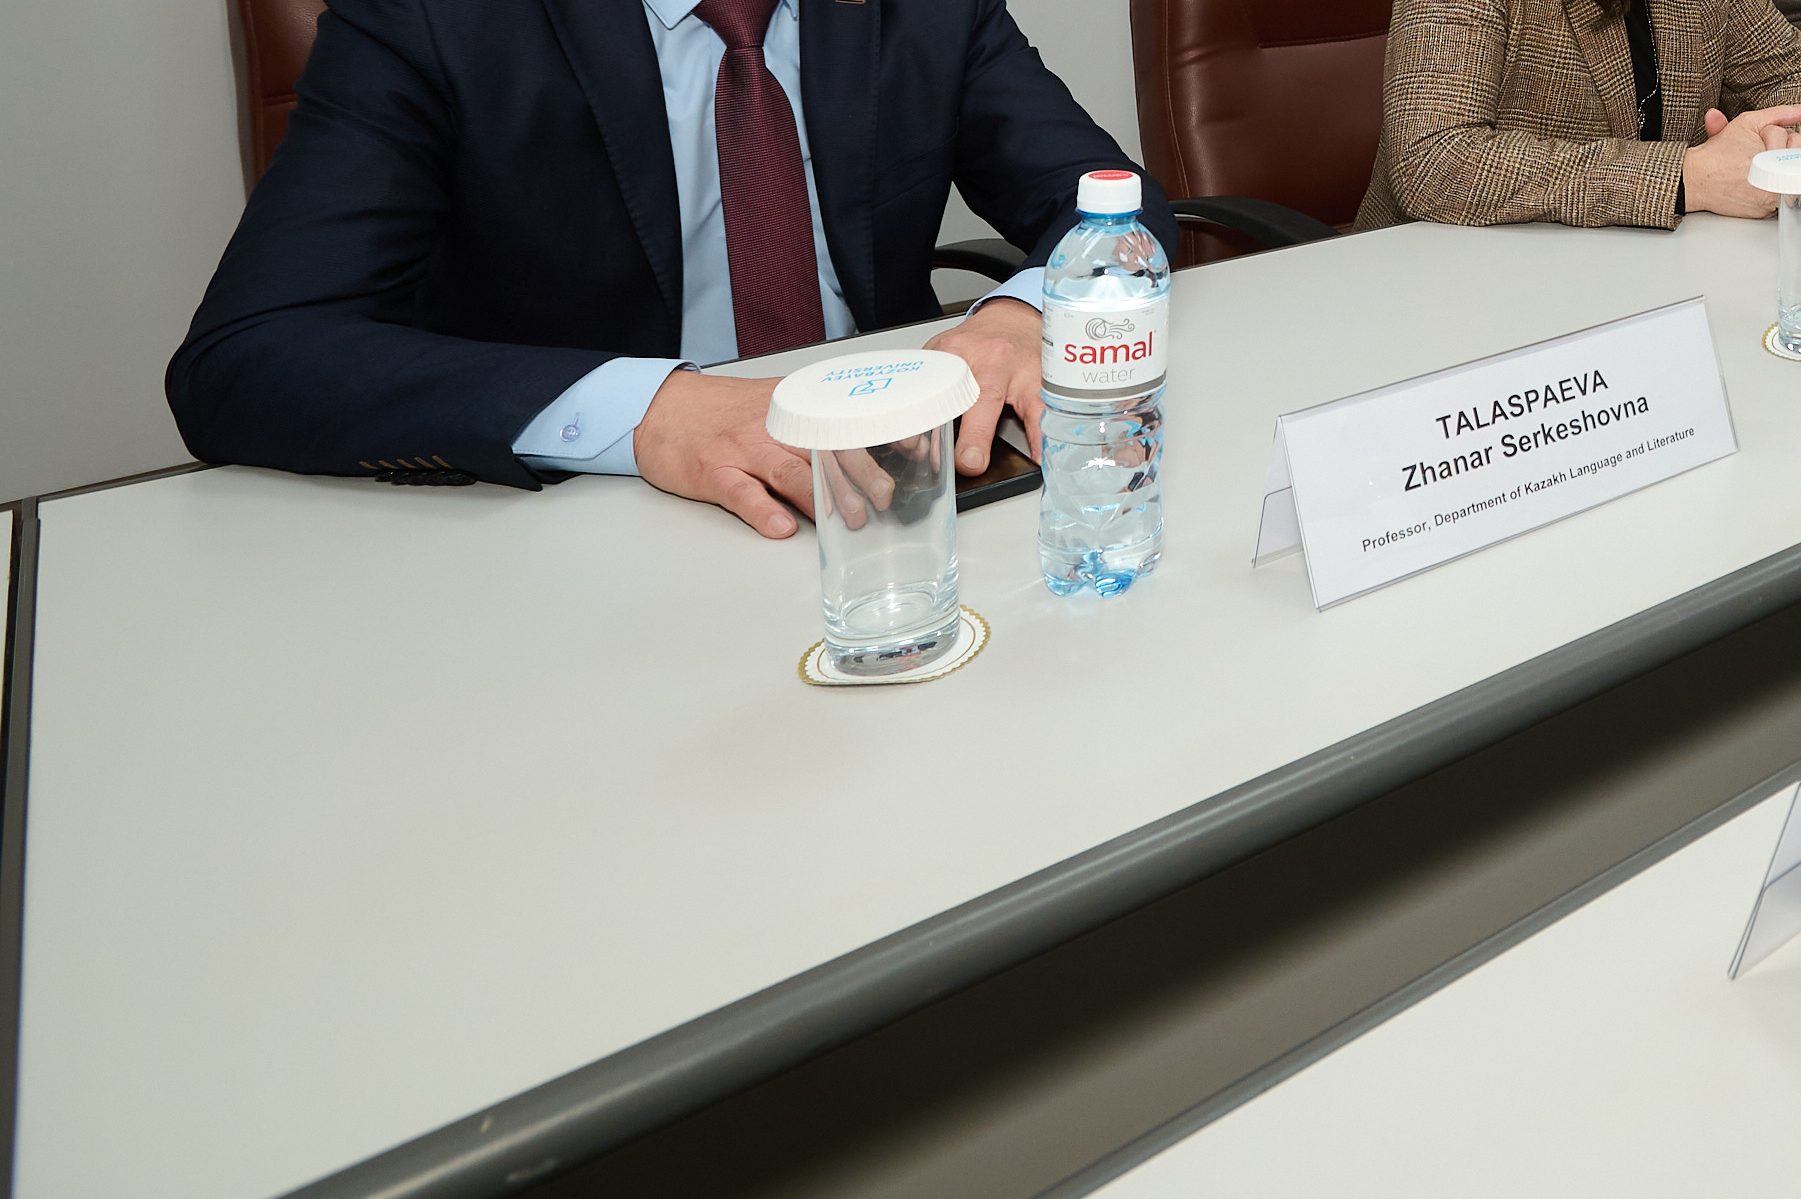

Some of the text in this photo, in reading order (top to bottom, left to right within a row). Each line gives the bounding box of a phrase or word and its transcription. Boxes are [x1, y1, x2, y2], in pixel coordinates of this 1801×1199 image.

[1064, 331, 1153, 364] samal
[820, 366, 921, 382] KOZYBAYEV
[825, 361, 924, 377] UNIVERSITY
[1082, 368, 1136, 384] water
[1436, 369, 1609, 440] TALASPAEVA
[1402, 394, 1650, 493] Zhanar Serkeshovna
[1362, 427, 1696, 552] Professor, Department of Kazakh Language and Literature
